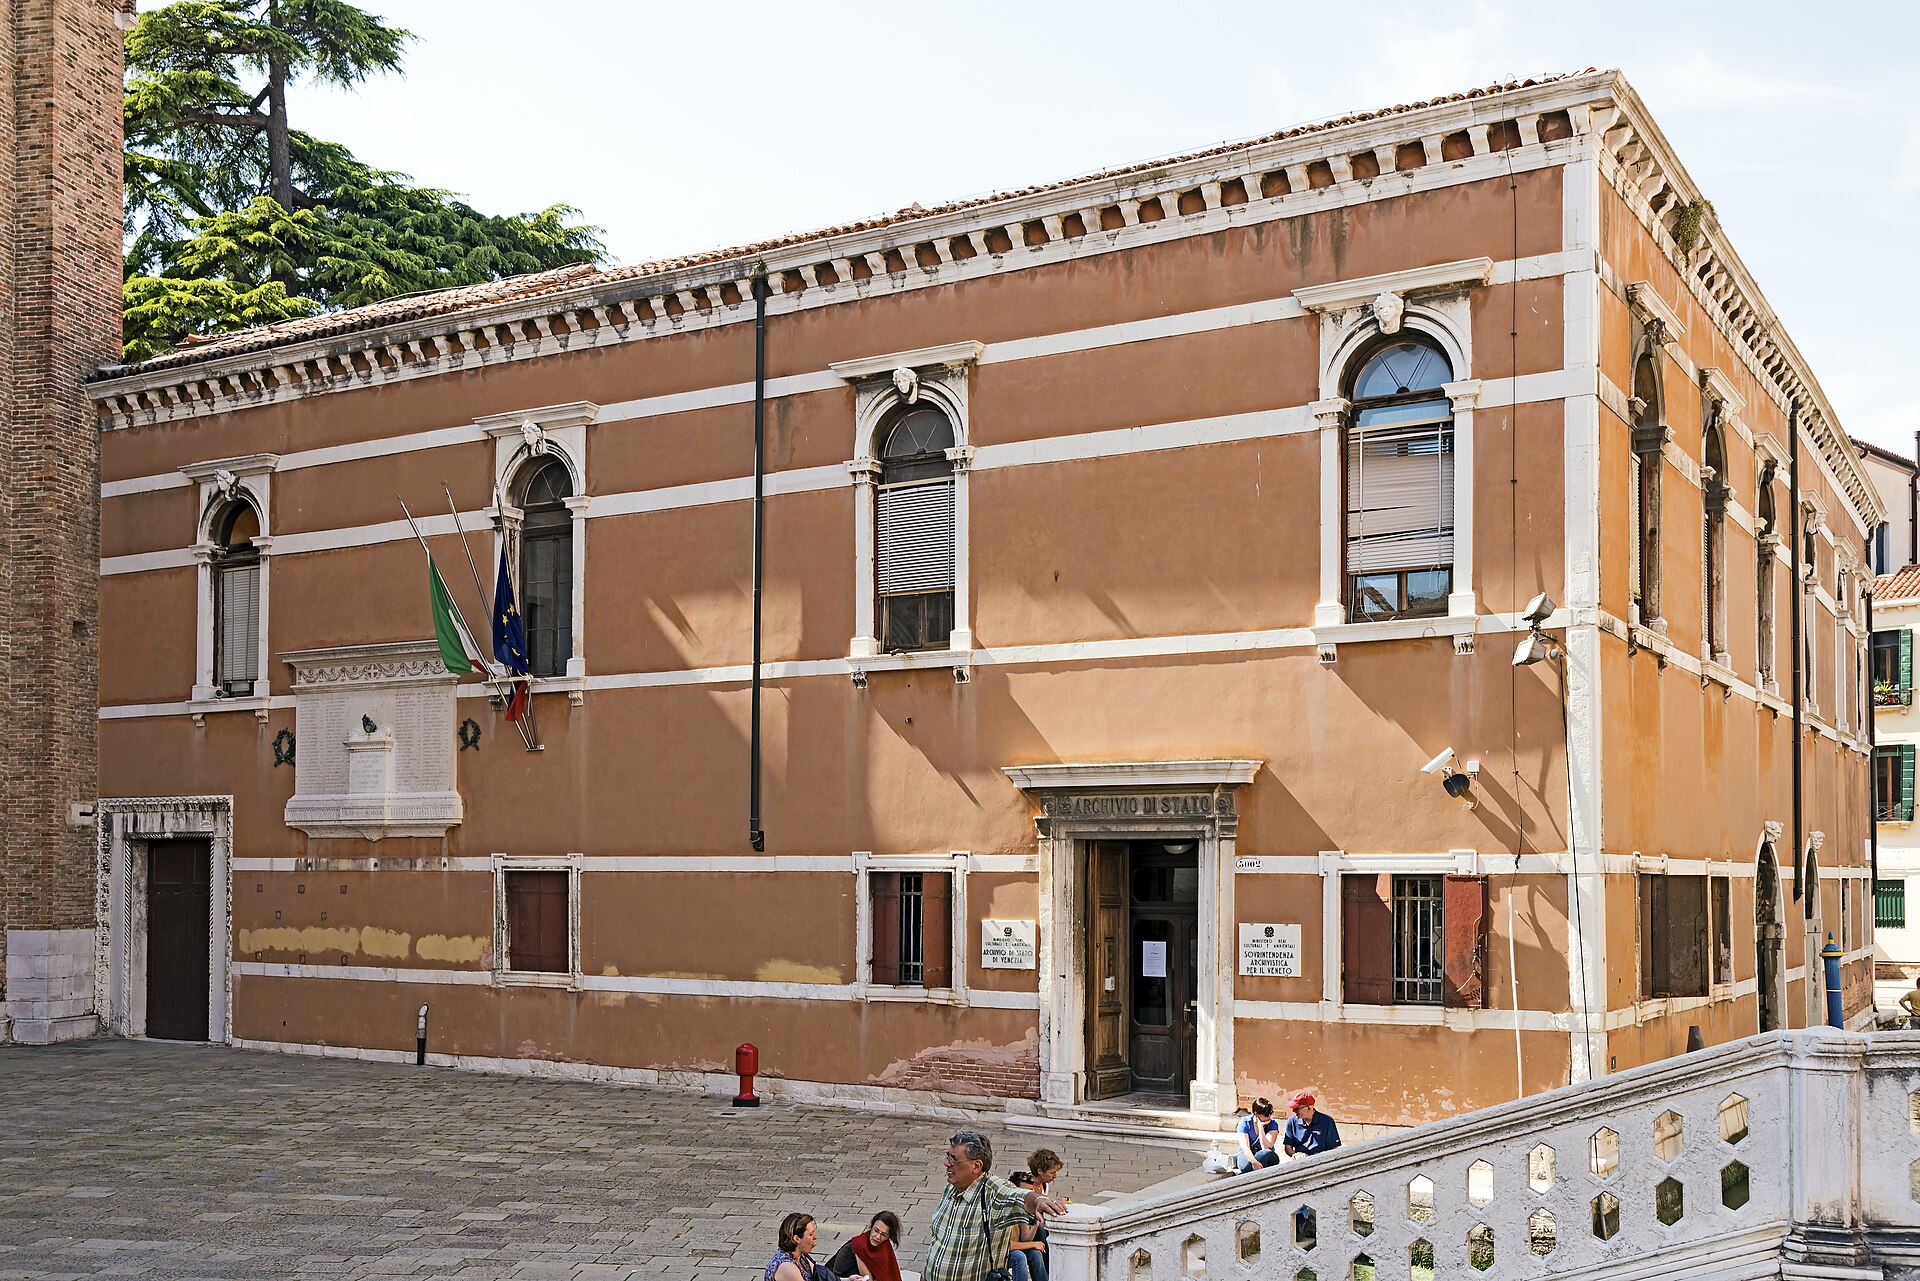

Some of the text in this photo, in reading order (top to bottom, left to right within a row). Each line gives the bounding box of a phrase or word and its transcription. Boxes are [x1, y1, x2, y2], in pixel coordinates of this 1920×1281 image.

[1074, 796, 1210, 814] ARCHIVIO DI STATO
